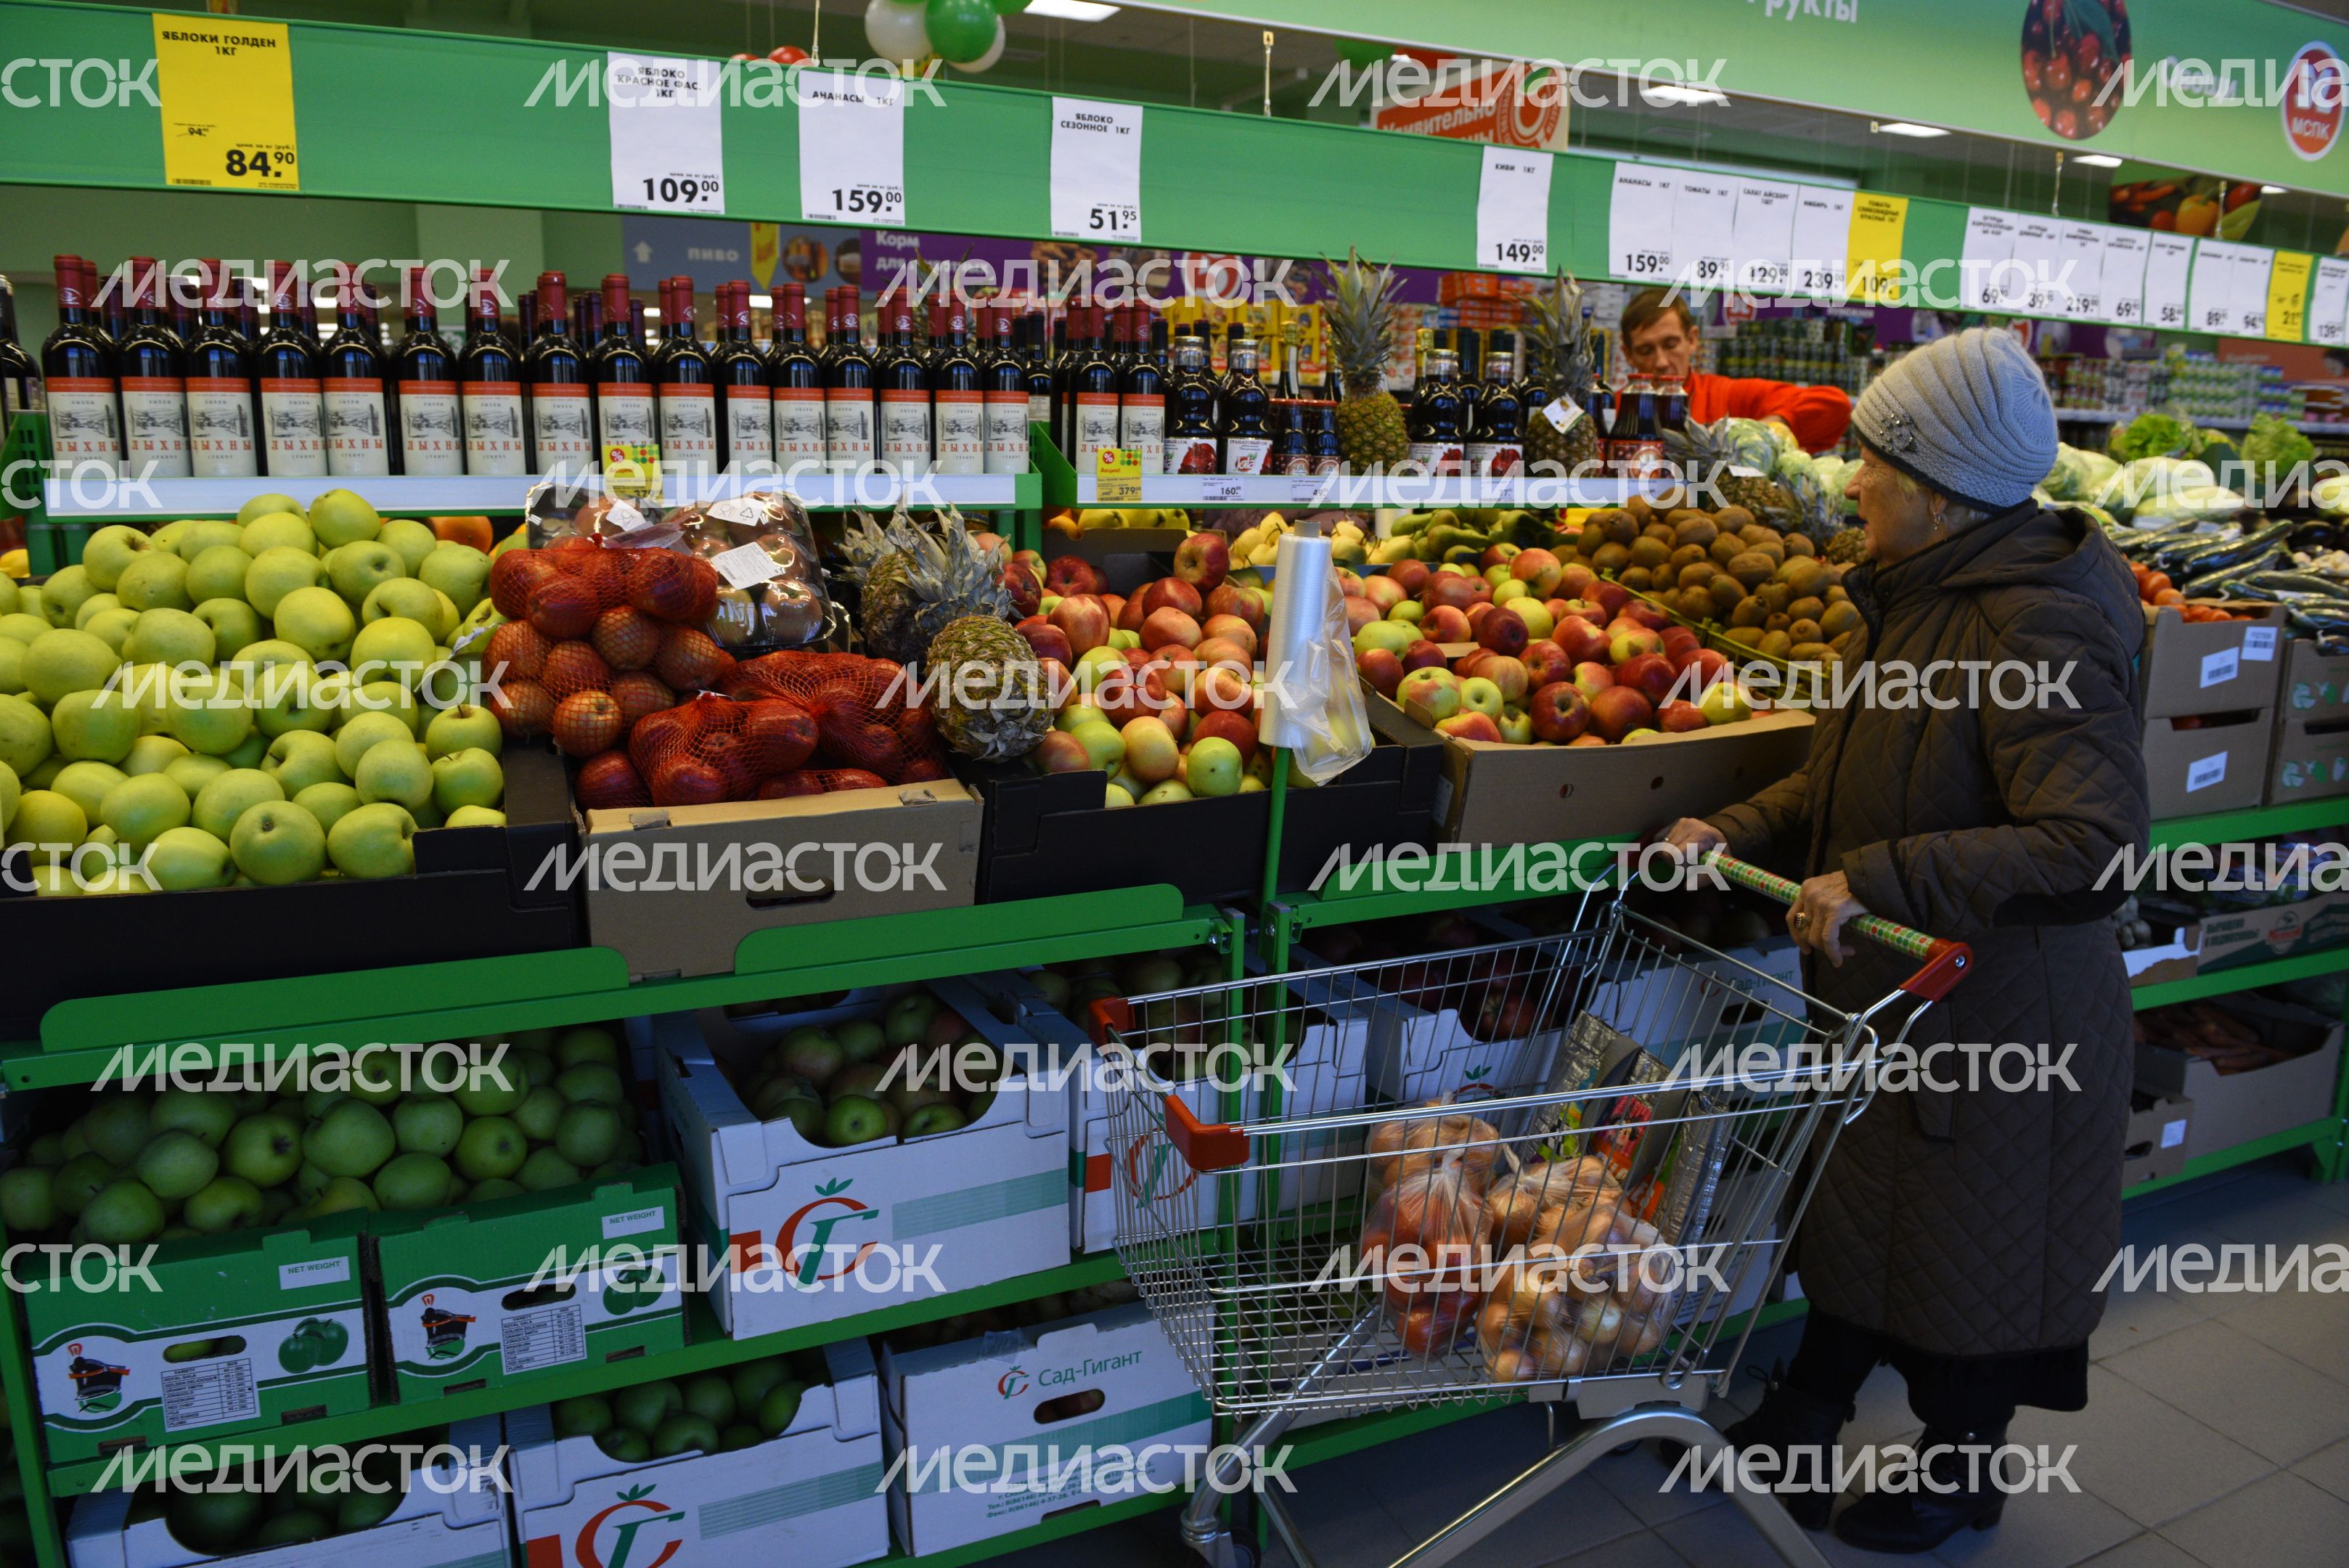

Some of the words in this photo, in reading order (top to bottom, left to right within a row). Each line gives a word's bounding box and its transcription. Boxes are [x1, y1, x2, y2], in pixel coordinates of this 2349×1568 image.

[1747, 0, 1858, 23] рукты
[163, 31, 218, 44] ЯБЛОКИ
[224, 36, 276, 48] ГОЛДЕН
[216, 46, 237, 56] 1КГ
[638, 65, 685, 79] ЯБЛОКО
[617, 75, 670, 88] КРАСНОЕ
[812, 90, 865, 103] АНАНАСЫ
[1075, 113, 1114, 124] ЯБЛОКО
[1061, 121, 1108, 133] СЕЗОННОЕ
[1115, 126, 1130, 135] 1КГ
[875, 231, 920, 251] Корм
[609, 1215, 625, 1225] NET
[626, 1210, 656, 1222] WEIGHT
[287, 1264, 306, 1275] NET
[307, 1260, 341, 1273] WEIGHT
[1038, 1350, 1143, 1387] Сад-Гигант
